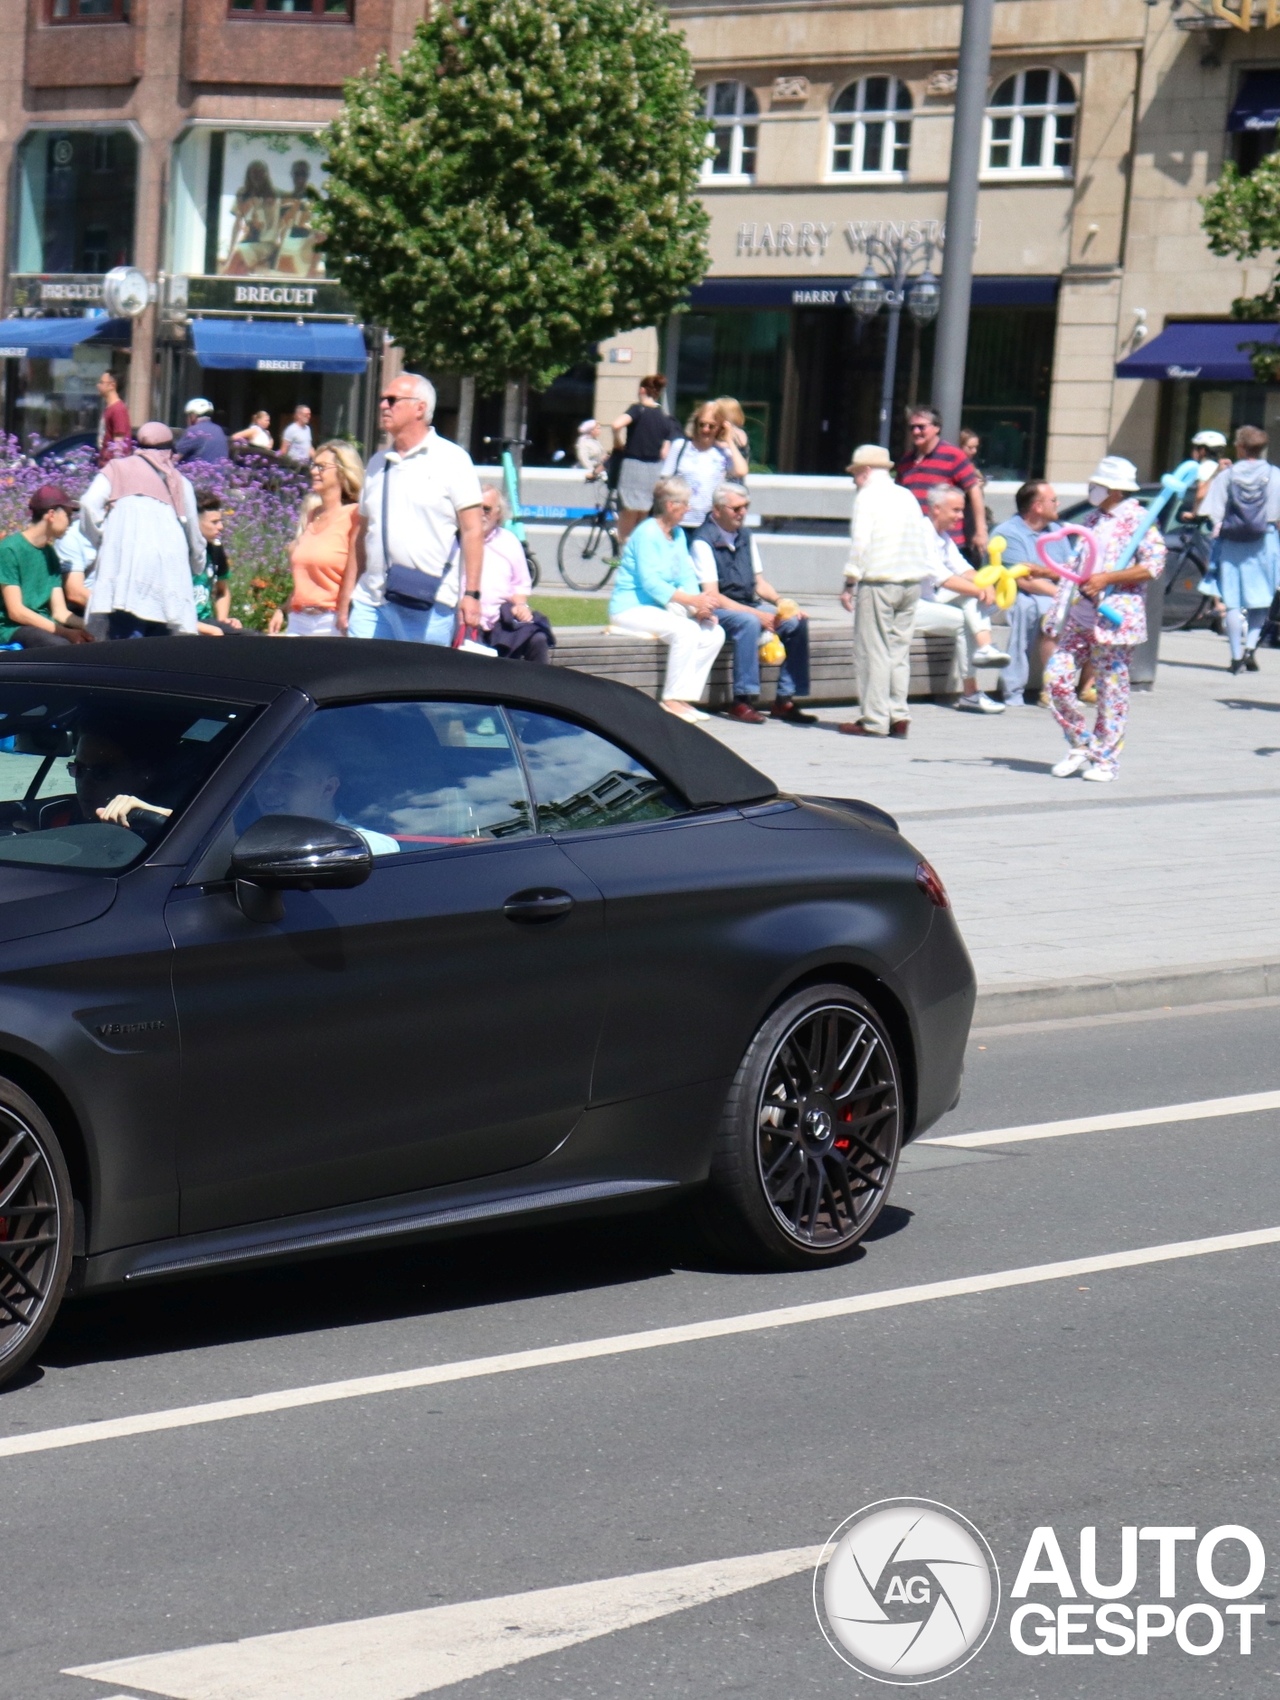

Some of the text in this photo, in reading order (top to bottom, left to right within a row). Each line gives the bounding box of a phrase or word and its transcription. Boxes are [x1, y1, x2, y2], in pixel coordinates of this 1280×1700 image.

[738, 219, 982, 249] HARRY WINST
[235, 286, 317, 304] BREGUET
[792, 290, 839, 303] HARRY
[257, 359, 306, 371] BREGUET
